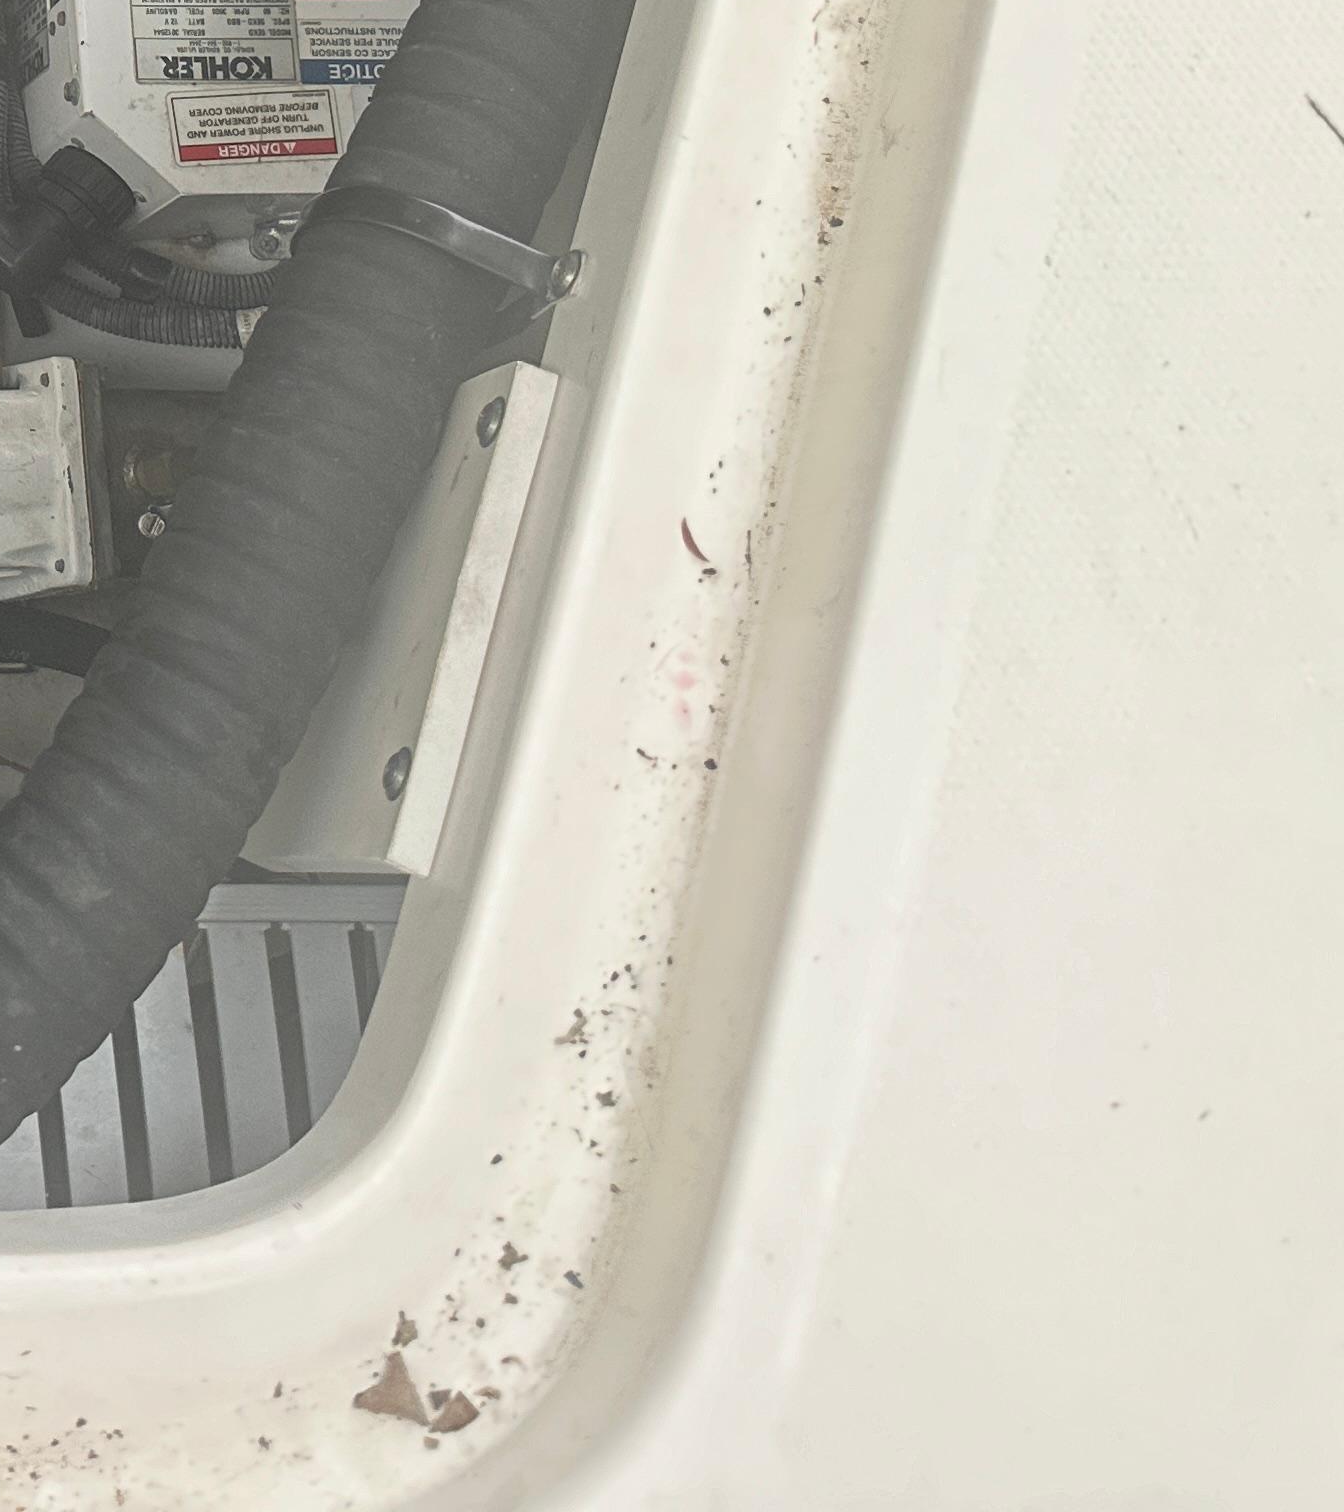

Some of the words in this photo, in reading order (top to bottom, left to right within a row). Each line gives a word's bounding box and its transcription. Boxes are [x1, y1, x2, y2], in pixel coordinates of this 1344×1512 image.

[305, 27, 376, 35] INSTRUCTIONS
[310, 38, 351, 46] SERVICE
[354, 38, 373, 46] PER
[312, 49, 351, 57] SENSOR
[354, 49, 368, 57] CO
[160, 56, 272, 80] KOHLER
[328, 63, 385, 80] OTICE
[225, 104, 276, 114] REMOVING
[279, 102, 319, 112] BEFORE
[189, 108, 222, 117] COVER
[199, 116, 258, 127] GENERATOR
[261, 114, 280, 124] OFF
[282, 114, 308, 123] TURN
[210, 128, 246, 138] POWER
[248, 126, 281, 136] SHORE
[283, 124, 324, 133] UNPLUG
[187, 130, 207, 139] AND
[218, 142, 281, 157] DANGER
